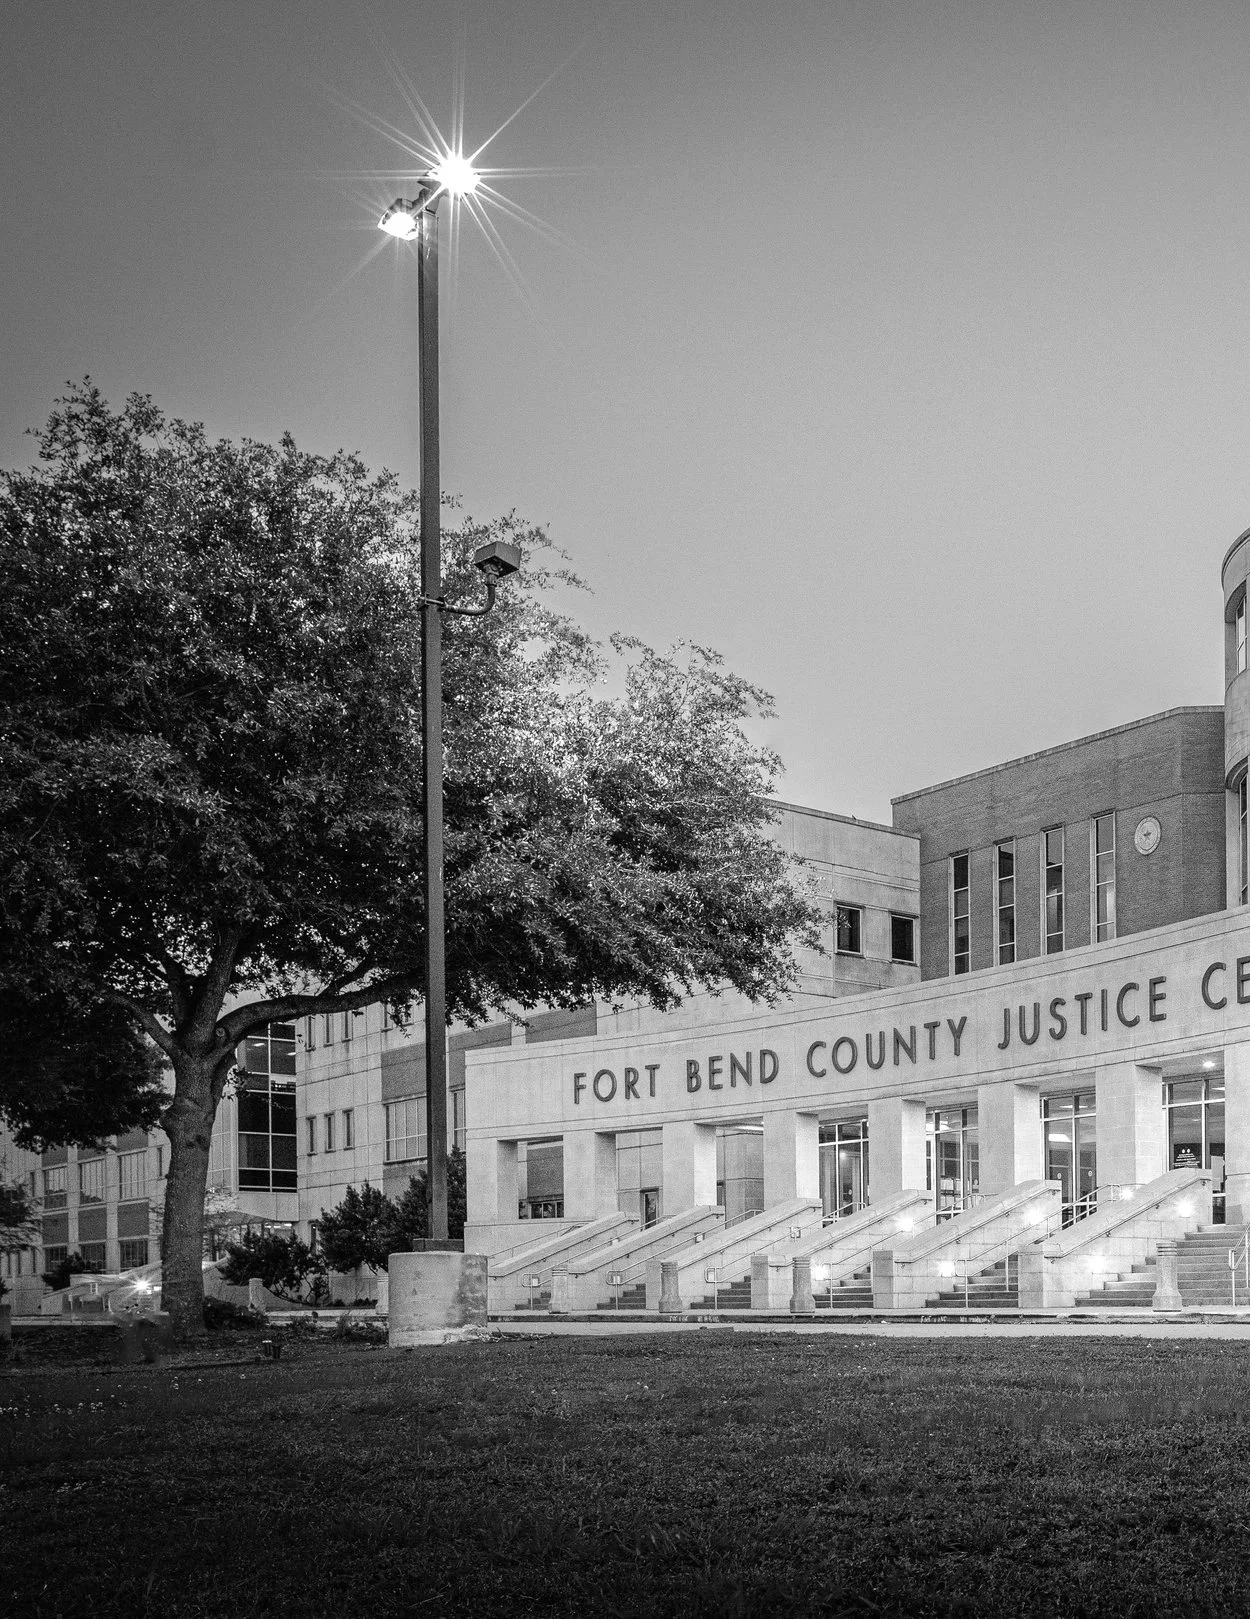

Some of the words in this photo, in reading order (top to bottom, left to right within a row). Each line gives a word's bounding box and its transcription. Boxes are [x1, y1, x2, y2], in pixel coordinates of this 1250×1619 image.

[573, 1063, 661, 1104] FORT
[686, 1048, 779, 1093] BEND
[806, 1015, 968, 1078] COUNTY
[997, 975, 1167, 1050] JUSTICE
